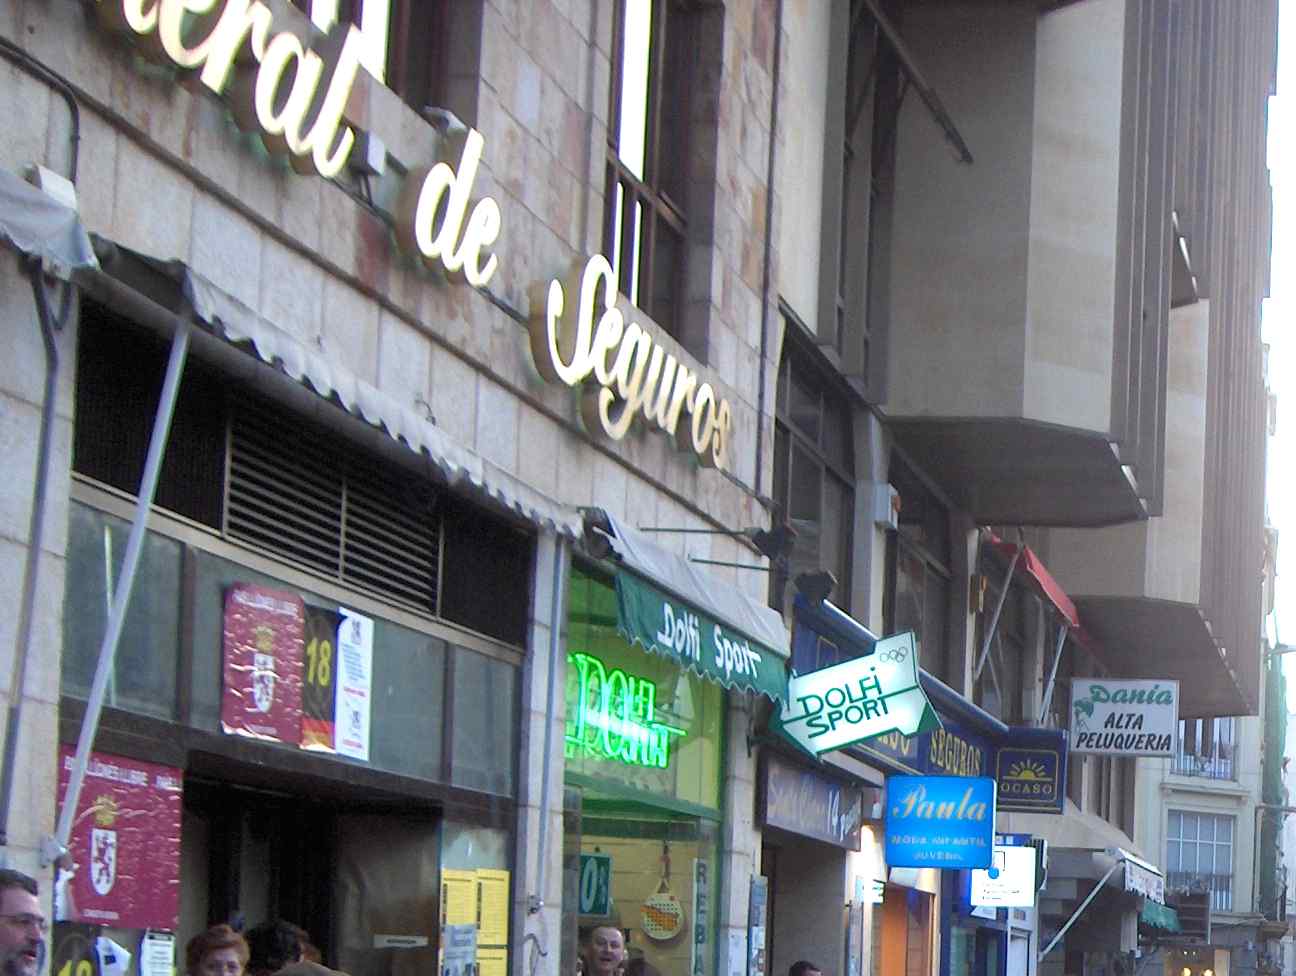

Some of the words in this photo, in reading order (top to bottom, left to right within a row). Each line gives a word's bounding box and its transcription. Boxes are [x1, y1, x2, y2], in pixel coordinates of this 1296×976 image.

[415, 128, 501, 287] de
[547, 254, 731, 470] Seguros
[657, 602, 701, 662] Dolfi
[713, 624, 762, 680] Sport
[306, 636, 332, 688] 18
[1087, 684, 1174, 705] Dania
[805, 697, 888, 739] SPORT
[1104, 711, 1144, 730] ALTA
[930, 727, 981, 777] SEGUROS
[1075, 732, 1172, 751] PELUQUERIA
[891, 783, 987, 822] Paula
[1000, 783, 1052, 794] OCASO
